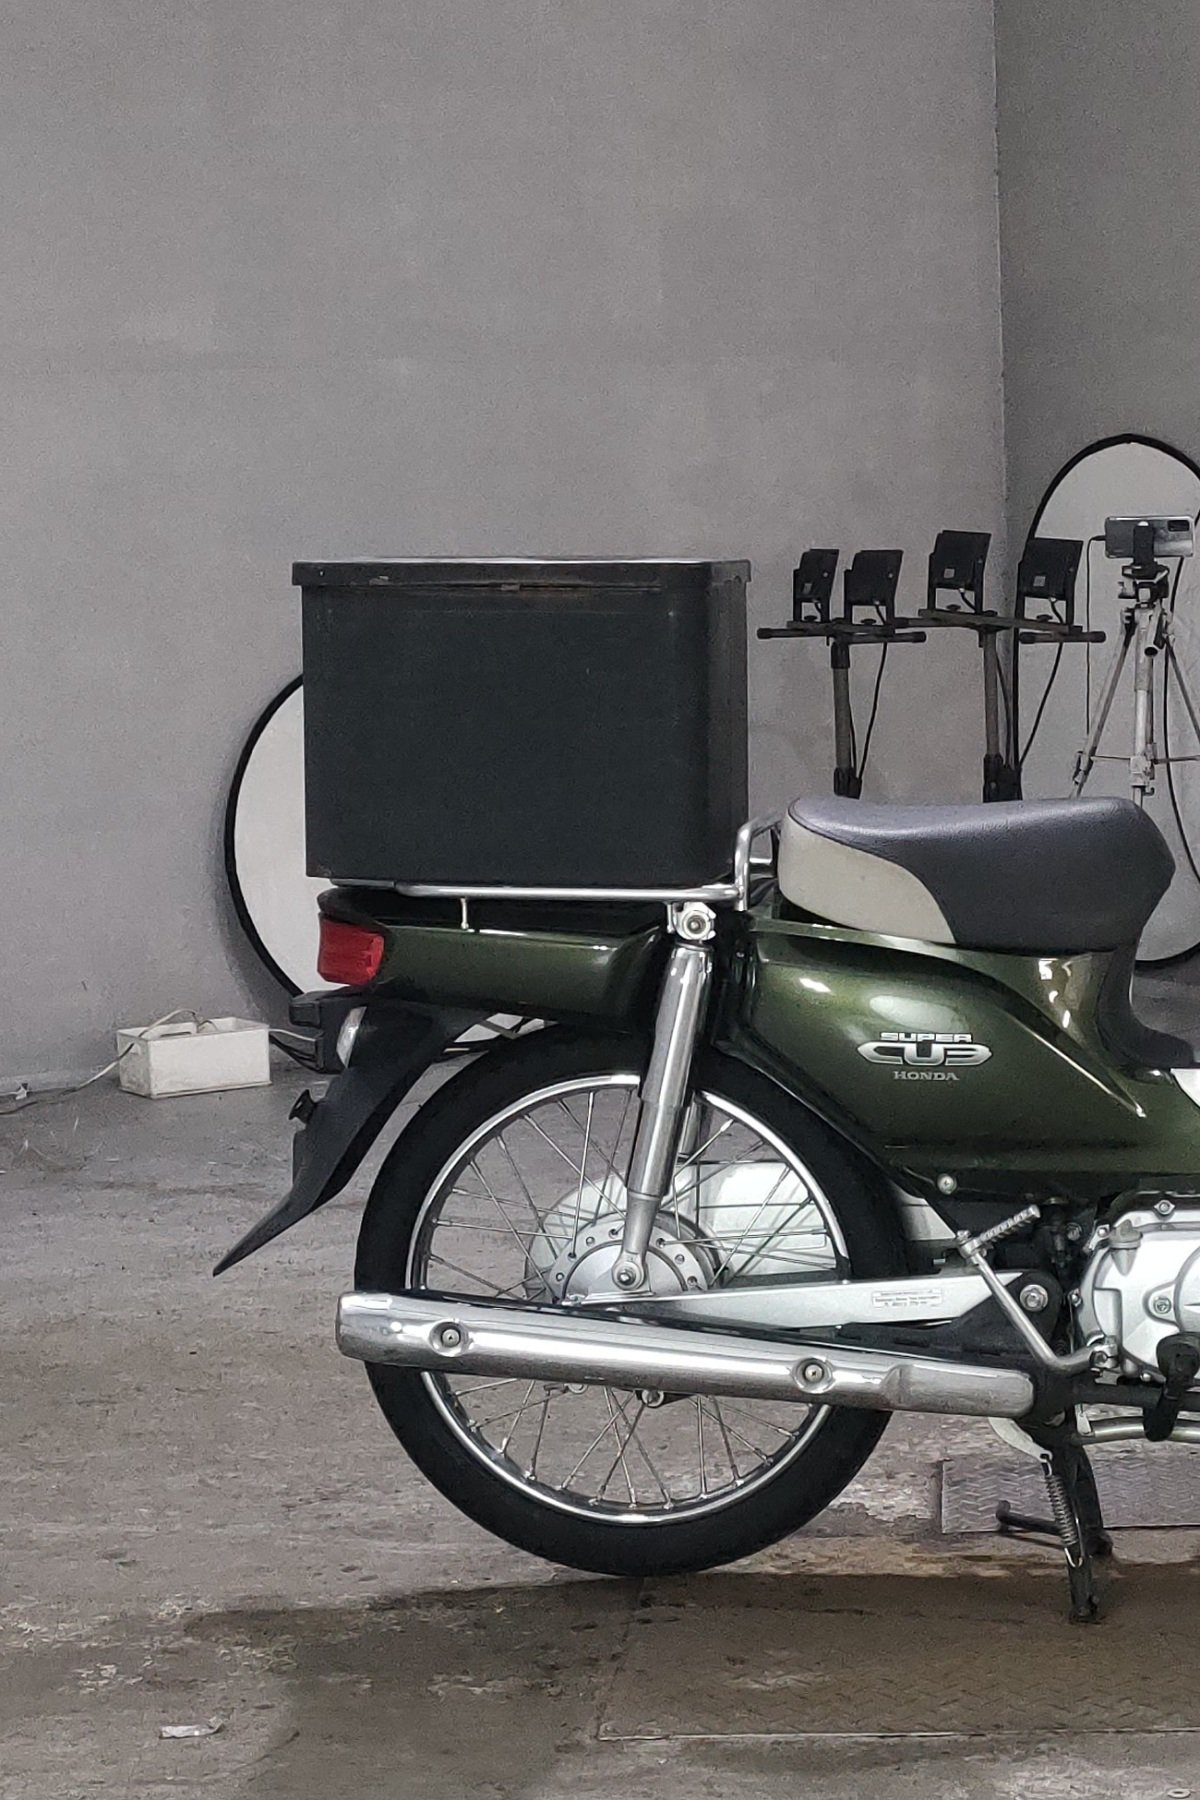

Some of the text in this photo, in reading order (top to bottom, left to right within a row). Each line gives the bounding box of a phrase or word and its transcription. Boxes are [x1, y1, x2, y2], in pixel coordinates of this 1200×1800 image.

[880, 1032, 972, 1042] SUPER
[857, 1041, 992, 1066] CUB
[893, 1071, 959, 1081] HONDA
